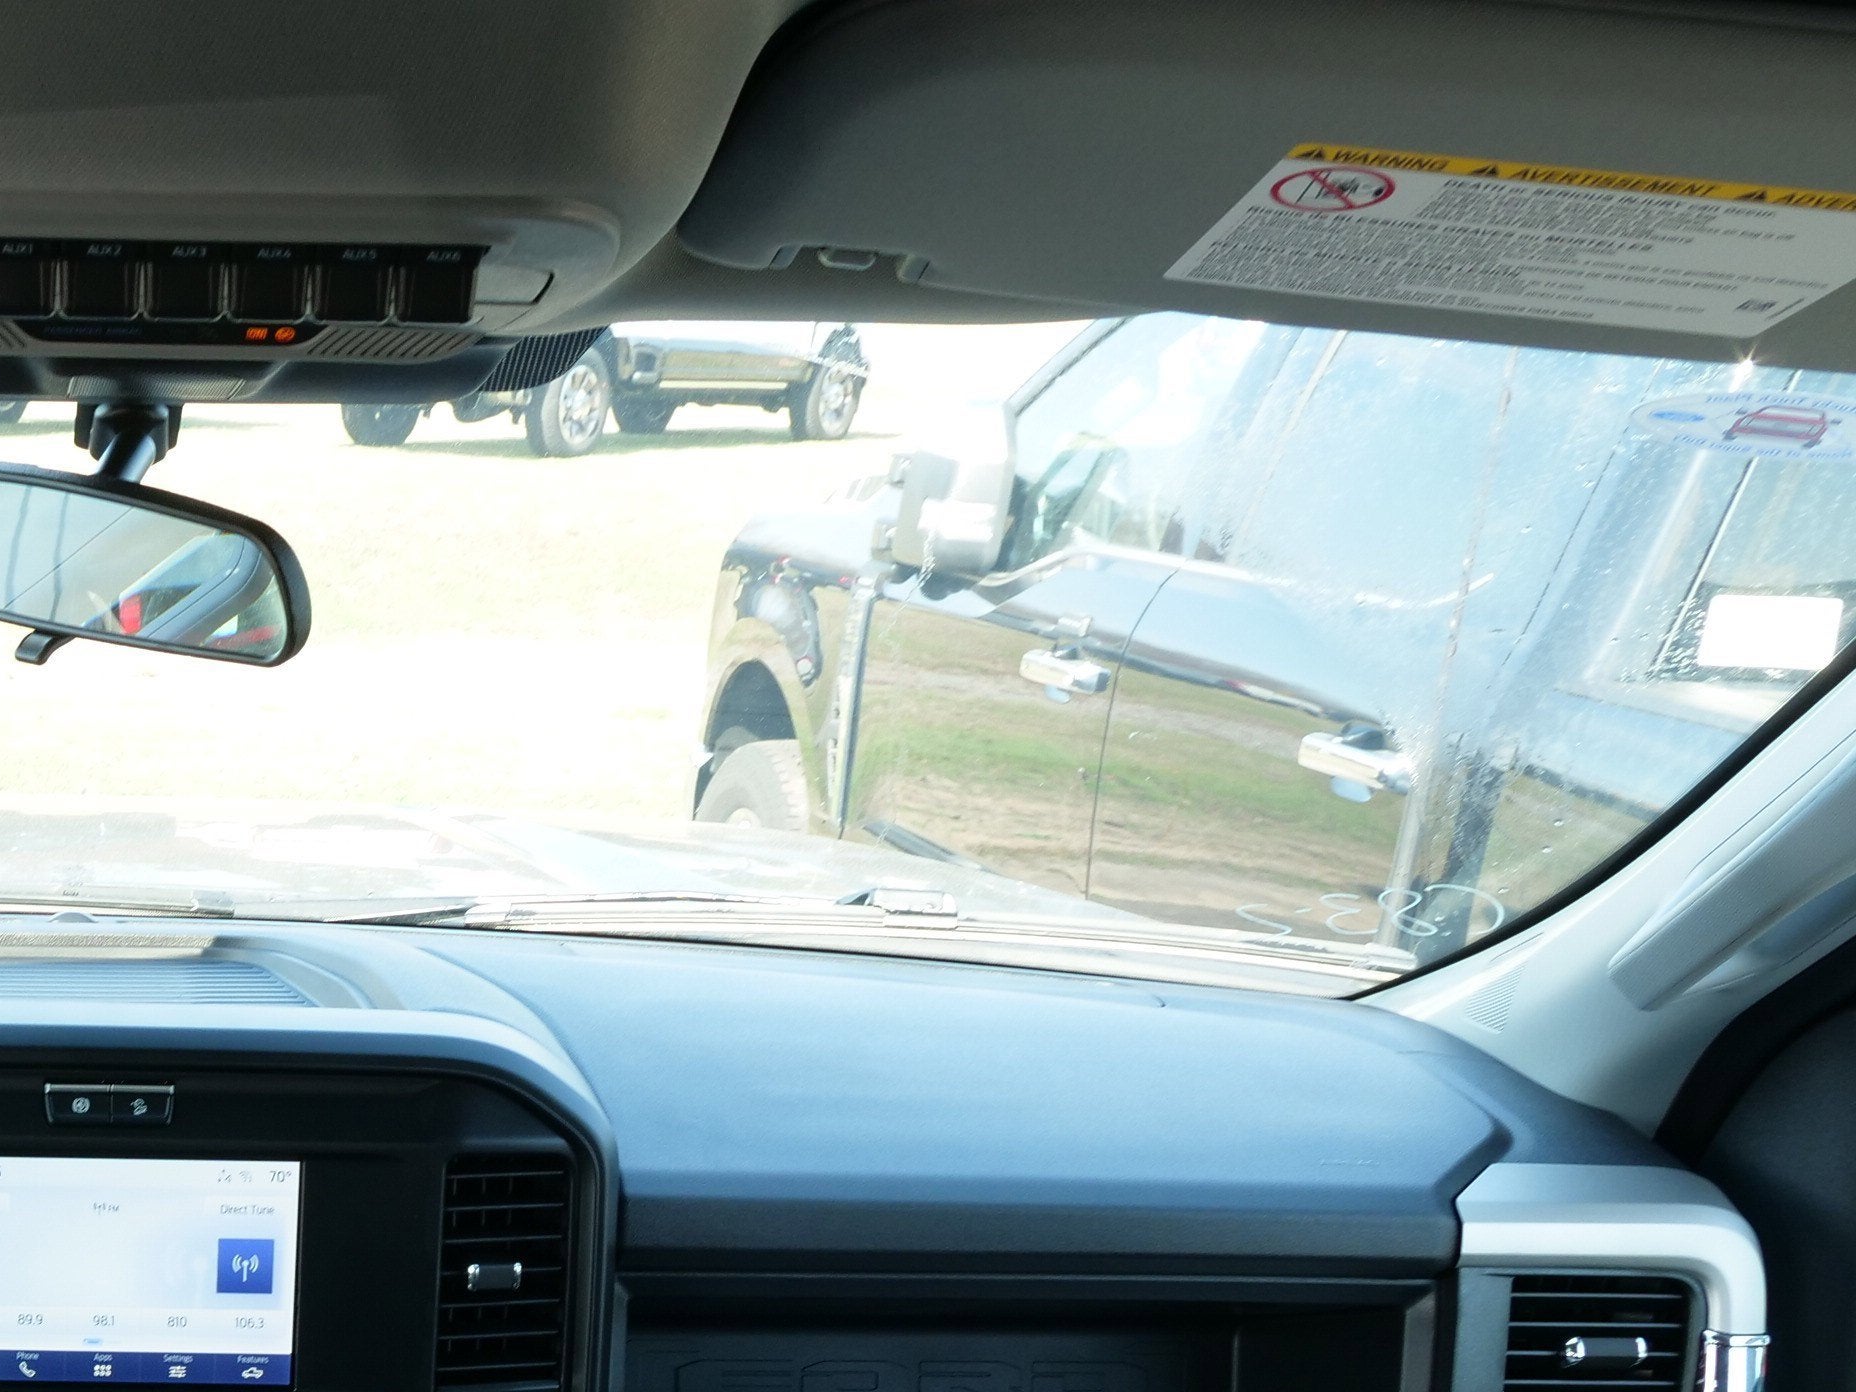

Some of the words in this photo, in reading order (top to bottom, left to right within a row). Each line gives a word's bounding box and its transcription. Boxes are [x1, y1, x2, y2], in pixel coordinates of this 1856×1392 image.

[1334, 151, 1450, 170] WARNING
[17, 1313, 44, 1326] 89.9
[93, 1315, 116, 1327] 98.1
[166, 1316, 187, 1328] 810
[234, 1316, 265, 1329] 106.3
[16, 1351, 40, 1361] Phone
